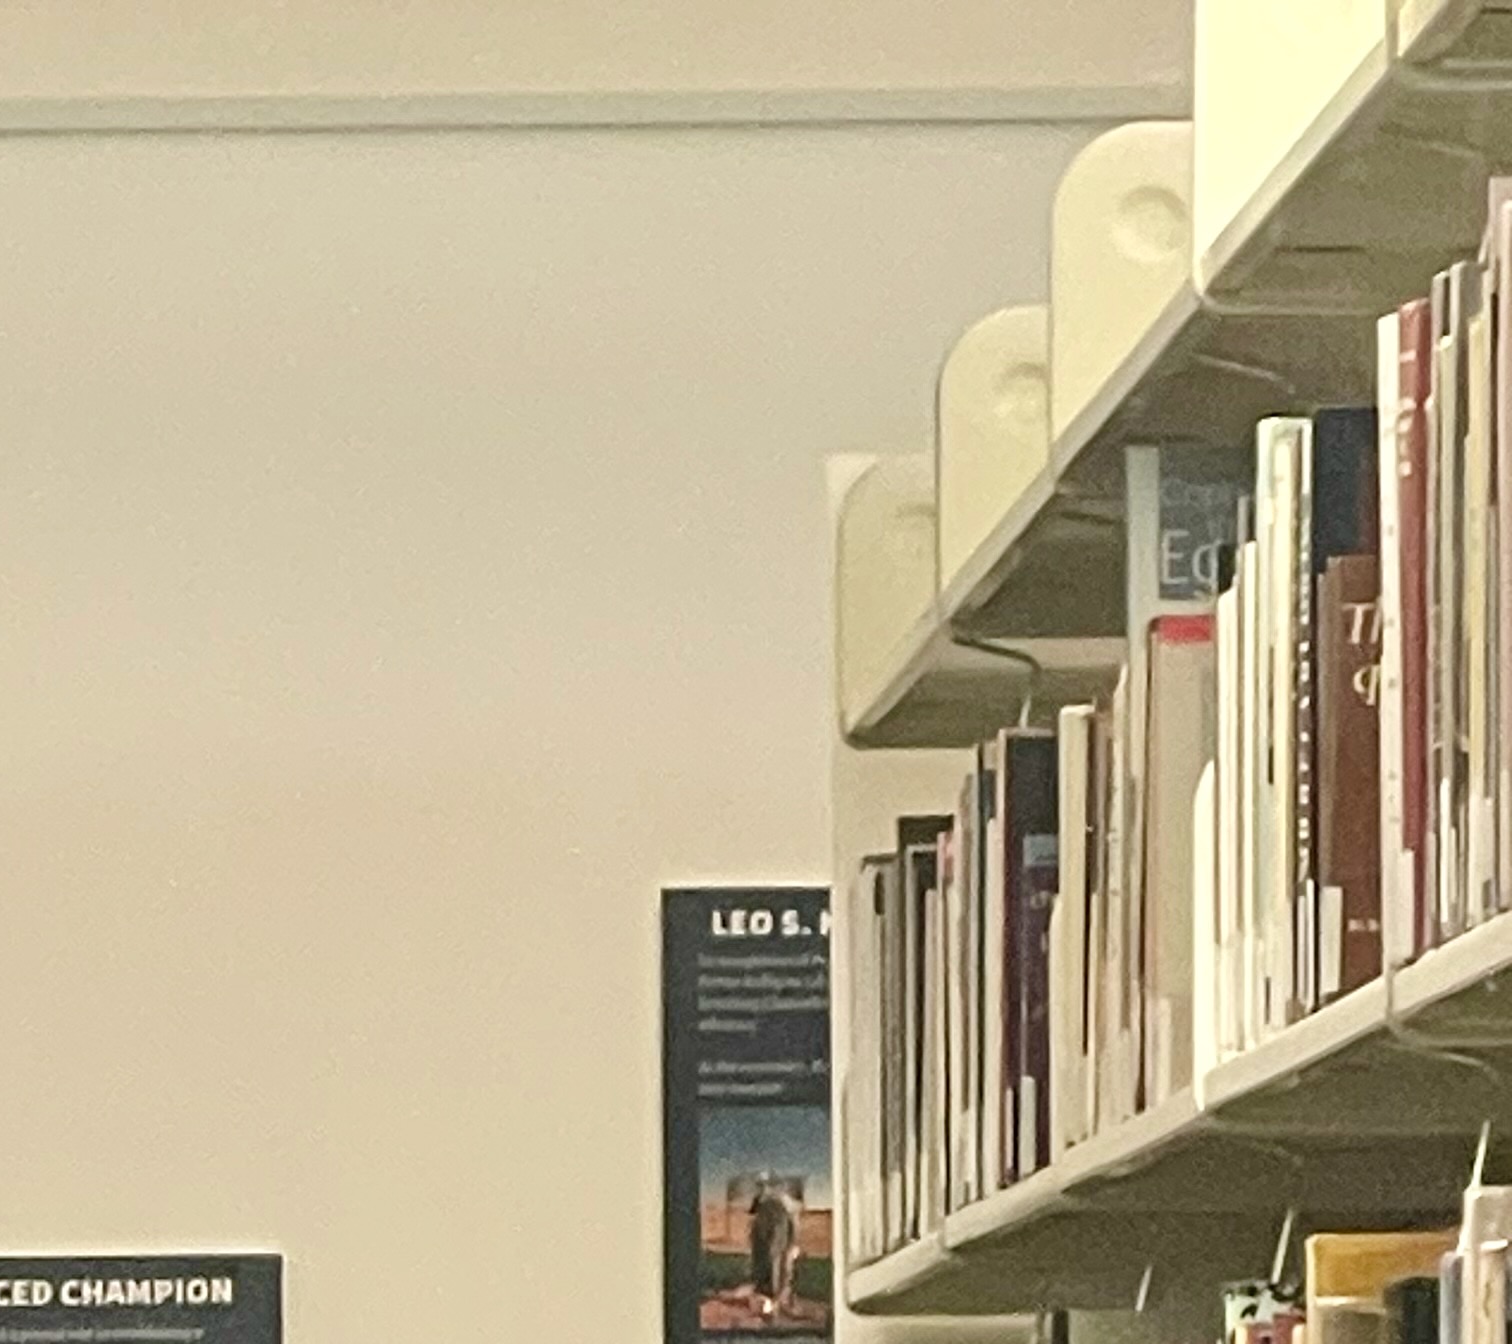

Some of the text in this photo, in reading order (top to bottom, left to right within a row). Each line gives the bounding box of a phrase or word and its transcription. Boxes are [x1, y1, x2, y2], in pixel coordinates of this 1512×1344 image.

[712, 910, 773, 935] LEO
[781, 910, 812, 935] S.
[60, 1277, 233, 1306] CHAMPION
